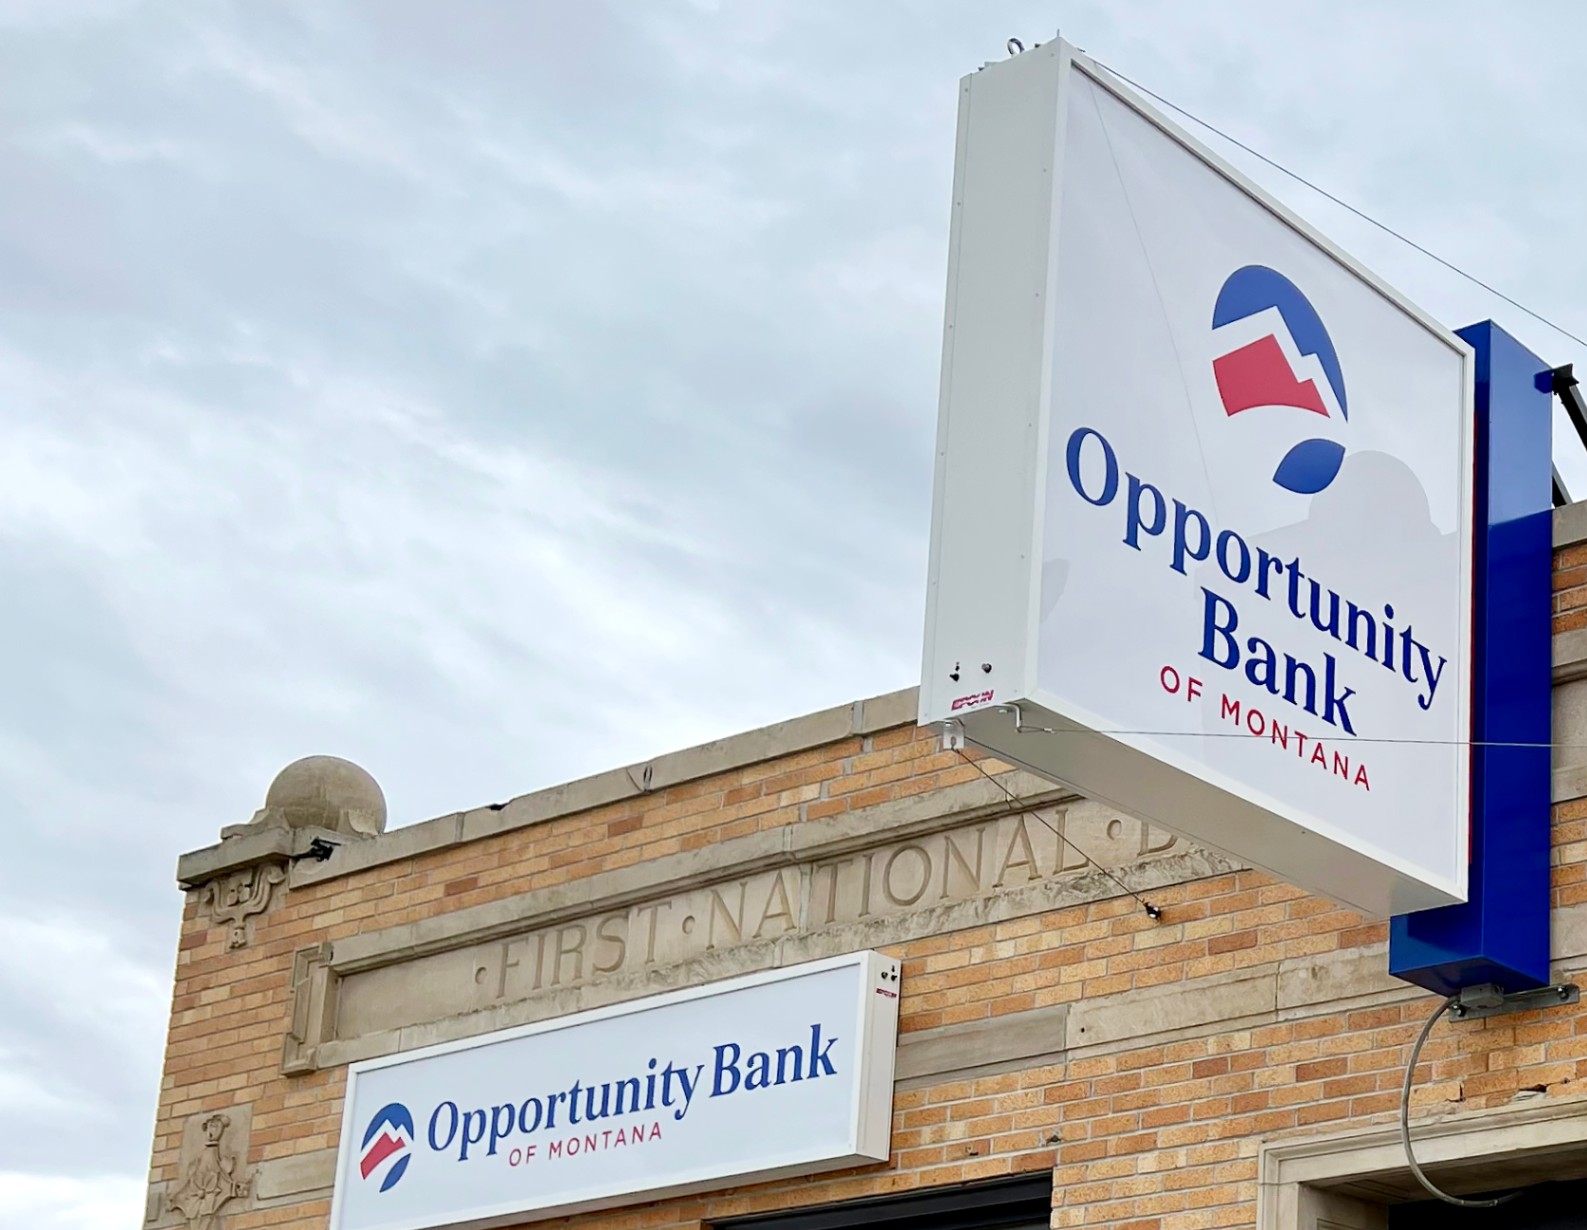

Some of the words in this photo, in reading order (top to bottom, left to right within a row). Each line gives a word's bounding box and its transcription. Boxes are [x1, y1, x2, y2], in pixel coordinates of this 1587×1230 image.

[1065, 426, 1448, 711] Opportunity
[1159, 665, 1204, 702] OF
[1220, 693, 1370, 791] MONTANA
[1197, 586, 1358, 737] Bank
[498, 900, 673, 999] FIRST
[706, 806, 1090, 951] NATIONAL
[427, 1057, 705, 1162] Opportunity
[709, 1023, 839, 1098] Bank
[508, 1144, 538, 1168] OF
[548, 1121, 663, 1161] MONTANA
